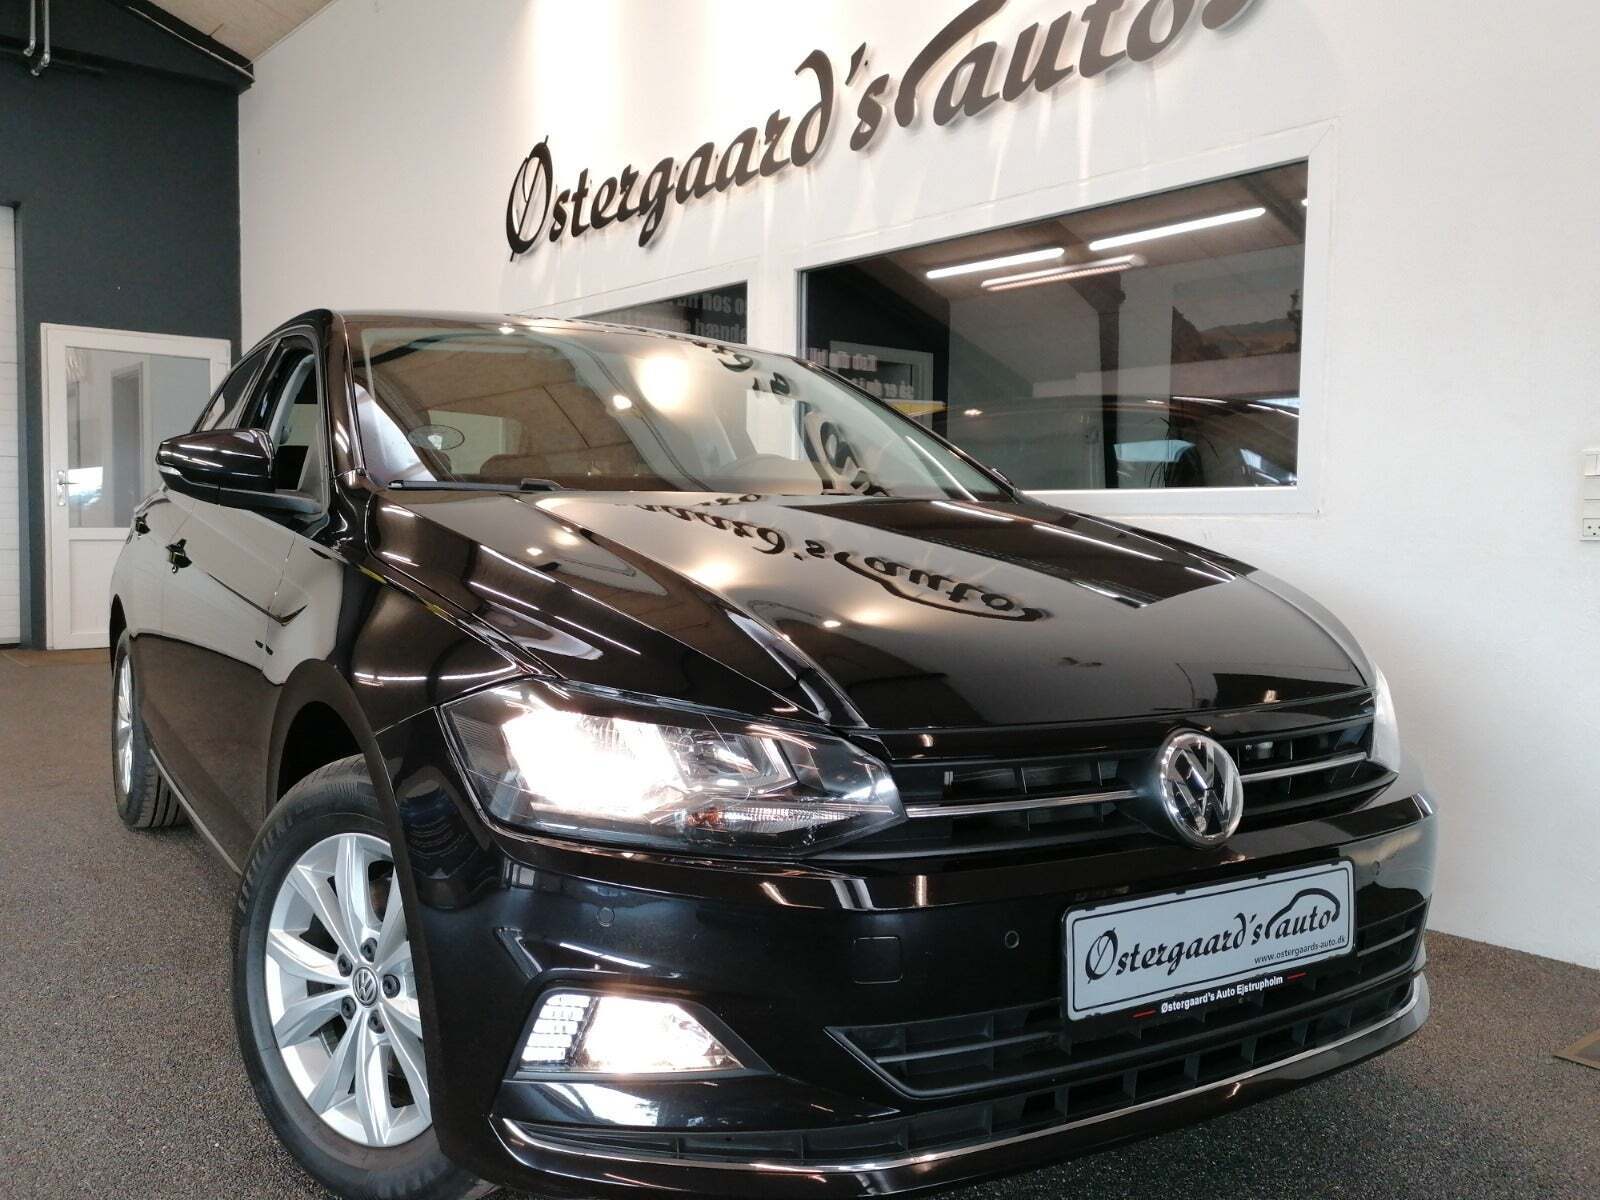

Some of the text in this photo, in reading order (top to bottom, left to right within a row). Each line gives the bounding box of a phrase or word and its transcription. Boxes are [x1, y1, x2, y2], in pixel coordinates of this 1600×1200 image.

[505, 0, 1200, 262] Østergaard's auto
[1085, 898, 1335, 984] Østergaard's auto
[1254, 935, 1346, 964] www.ostergaards-auto.dk
[1160, 975, 1284, 1014] Østergaard's Auto Ejstrupholm
